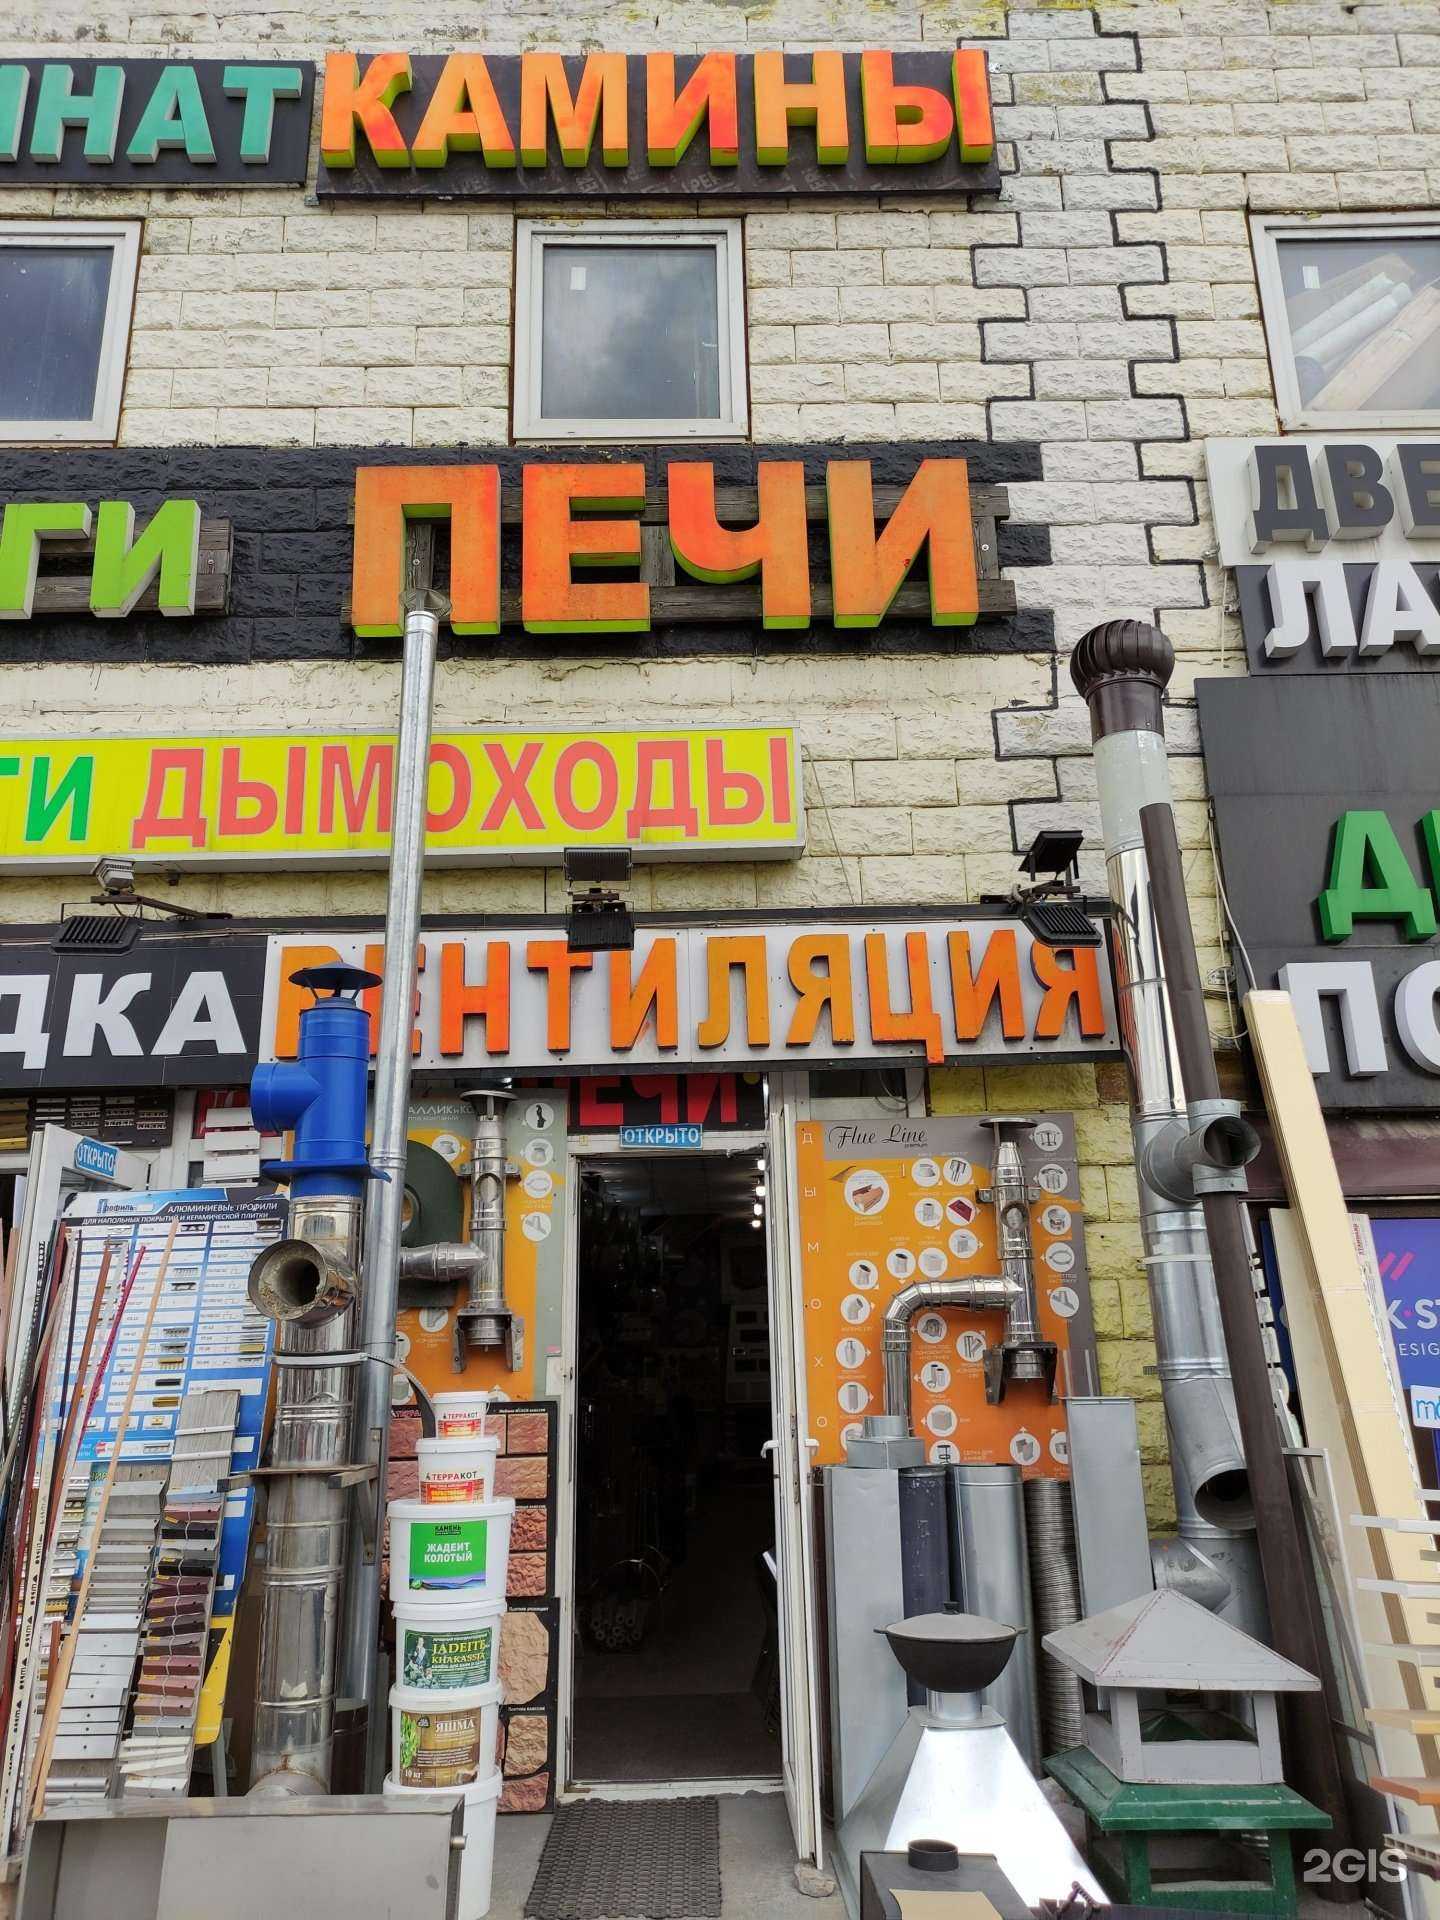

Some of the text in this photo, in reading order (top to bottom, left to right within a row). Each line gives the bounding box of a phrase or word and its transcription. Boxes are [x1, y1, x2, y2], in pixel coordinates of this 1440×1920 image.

[321, 50, 994, 168] КАМИНЫ
[1247, 443, 1440, 554] ДВЕ
[351, 459, 980, 638] ПЕЧИ
[0, 738, 792, 849] И ДЫМОХОДЫ
[521, 1074, 738, 1126] ЕЧИ
[624, 1127, 699, 1145] ОТКРЫТО
[829, 1124, 927, 1149] Flue Line
[77, 1142, 116, 1173] ОТКРЫТО
[168, 1202, 278, 1213] АЛЮМИНИЕВЫЕ ПРОФИЛИ
[82, 1217, 97, 1225] ДЛЯ
[447, 1412, 478, 1420] ТЕРРАКОТ
[432, 1471, 477, 1481] ТЕРРАКОТ
[427, 1542, 471, 1552] ЖАДЕИТ
[424, 1551, 473, 1563] КОЛОТЫЙ
[432, 1639, 486, 1655] JADEITE
[436, 1719, 475, 1733] ЯШМА
